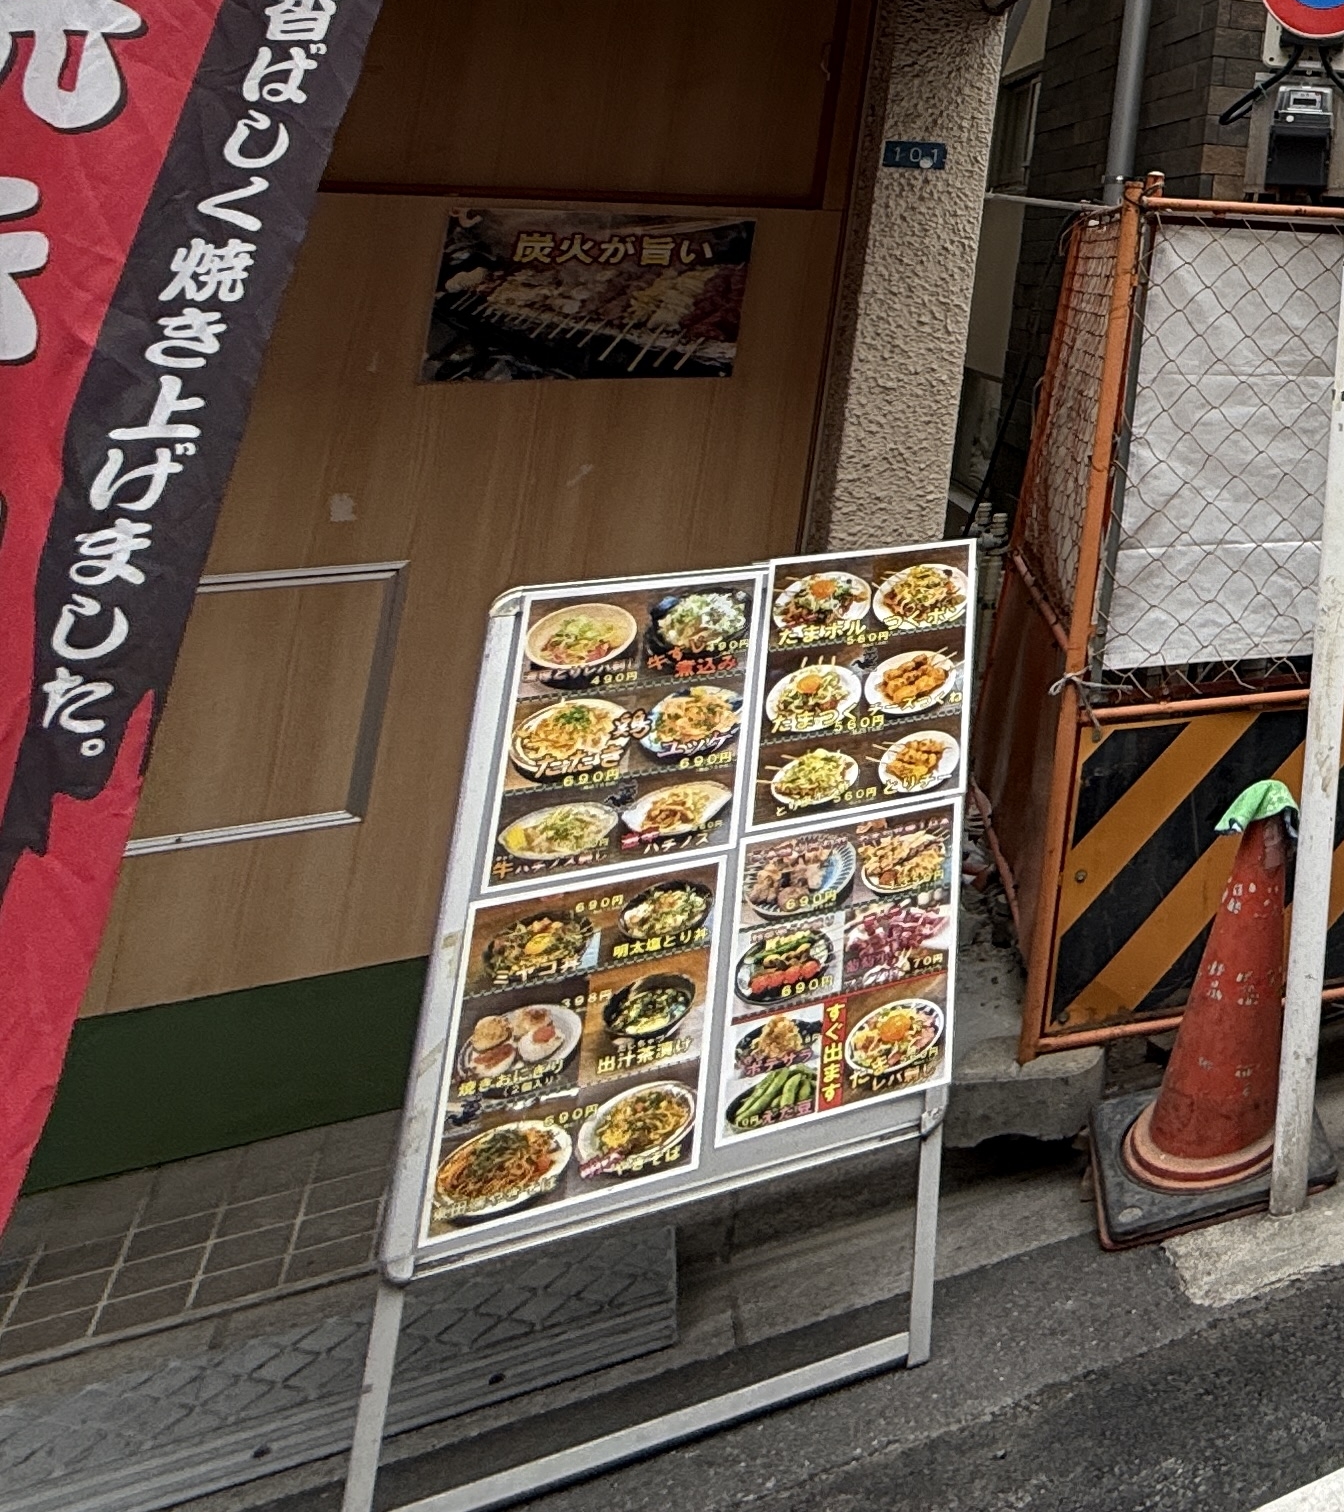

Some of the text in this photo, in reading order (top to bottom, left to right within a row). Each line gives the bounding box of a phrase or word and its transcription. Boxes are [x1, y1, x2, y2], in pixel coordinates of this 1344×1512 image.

[892, 144, 941, 164] 101
[513, 231, 714, 268] 炭火が旨い
[679, 751, 733, 770] 690円
[563, 769, 621, 787] 690円
[643, 833, 709, 854] ハチノス
[820, 1002, 846, 1103] すぐ出ます
